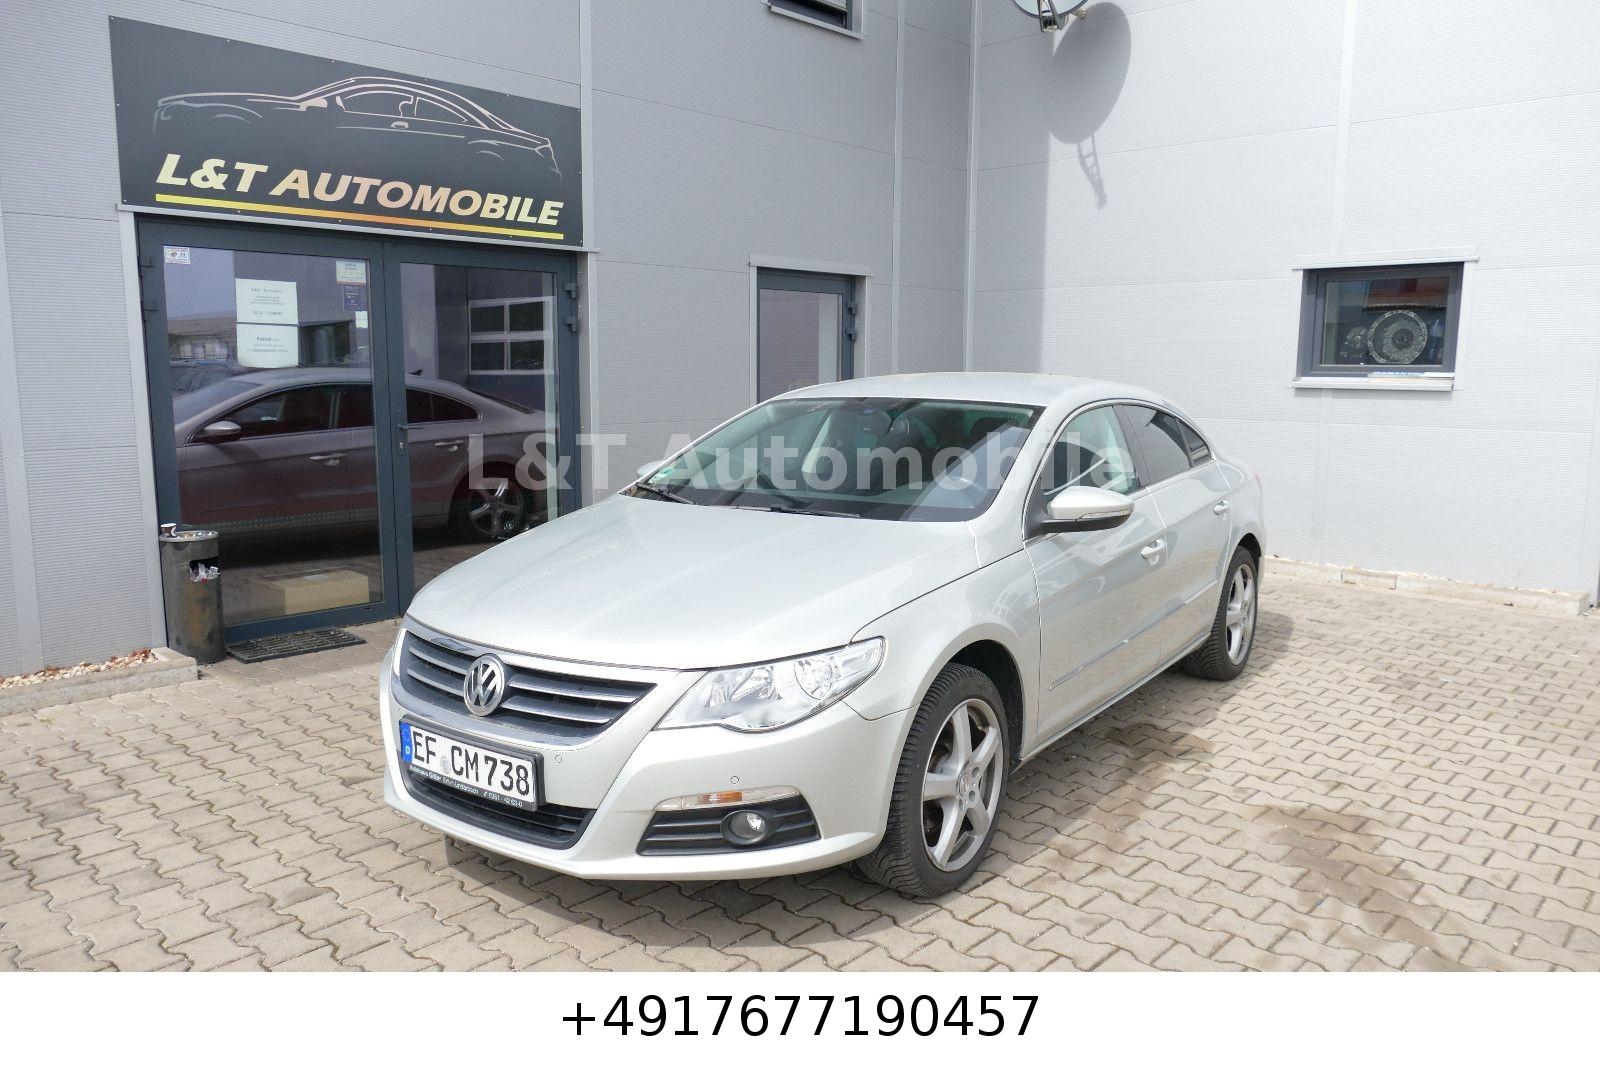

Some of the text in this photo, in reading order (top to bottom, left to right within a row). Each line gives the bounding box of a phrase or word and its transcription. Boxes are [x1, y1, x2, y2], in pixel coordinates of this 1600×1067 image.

[156, 153, 564, 226] L&T AUTOMOBILE
[413, 730, 437, 764] EF
